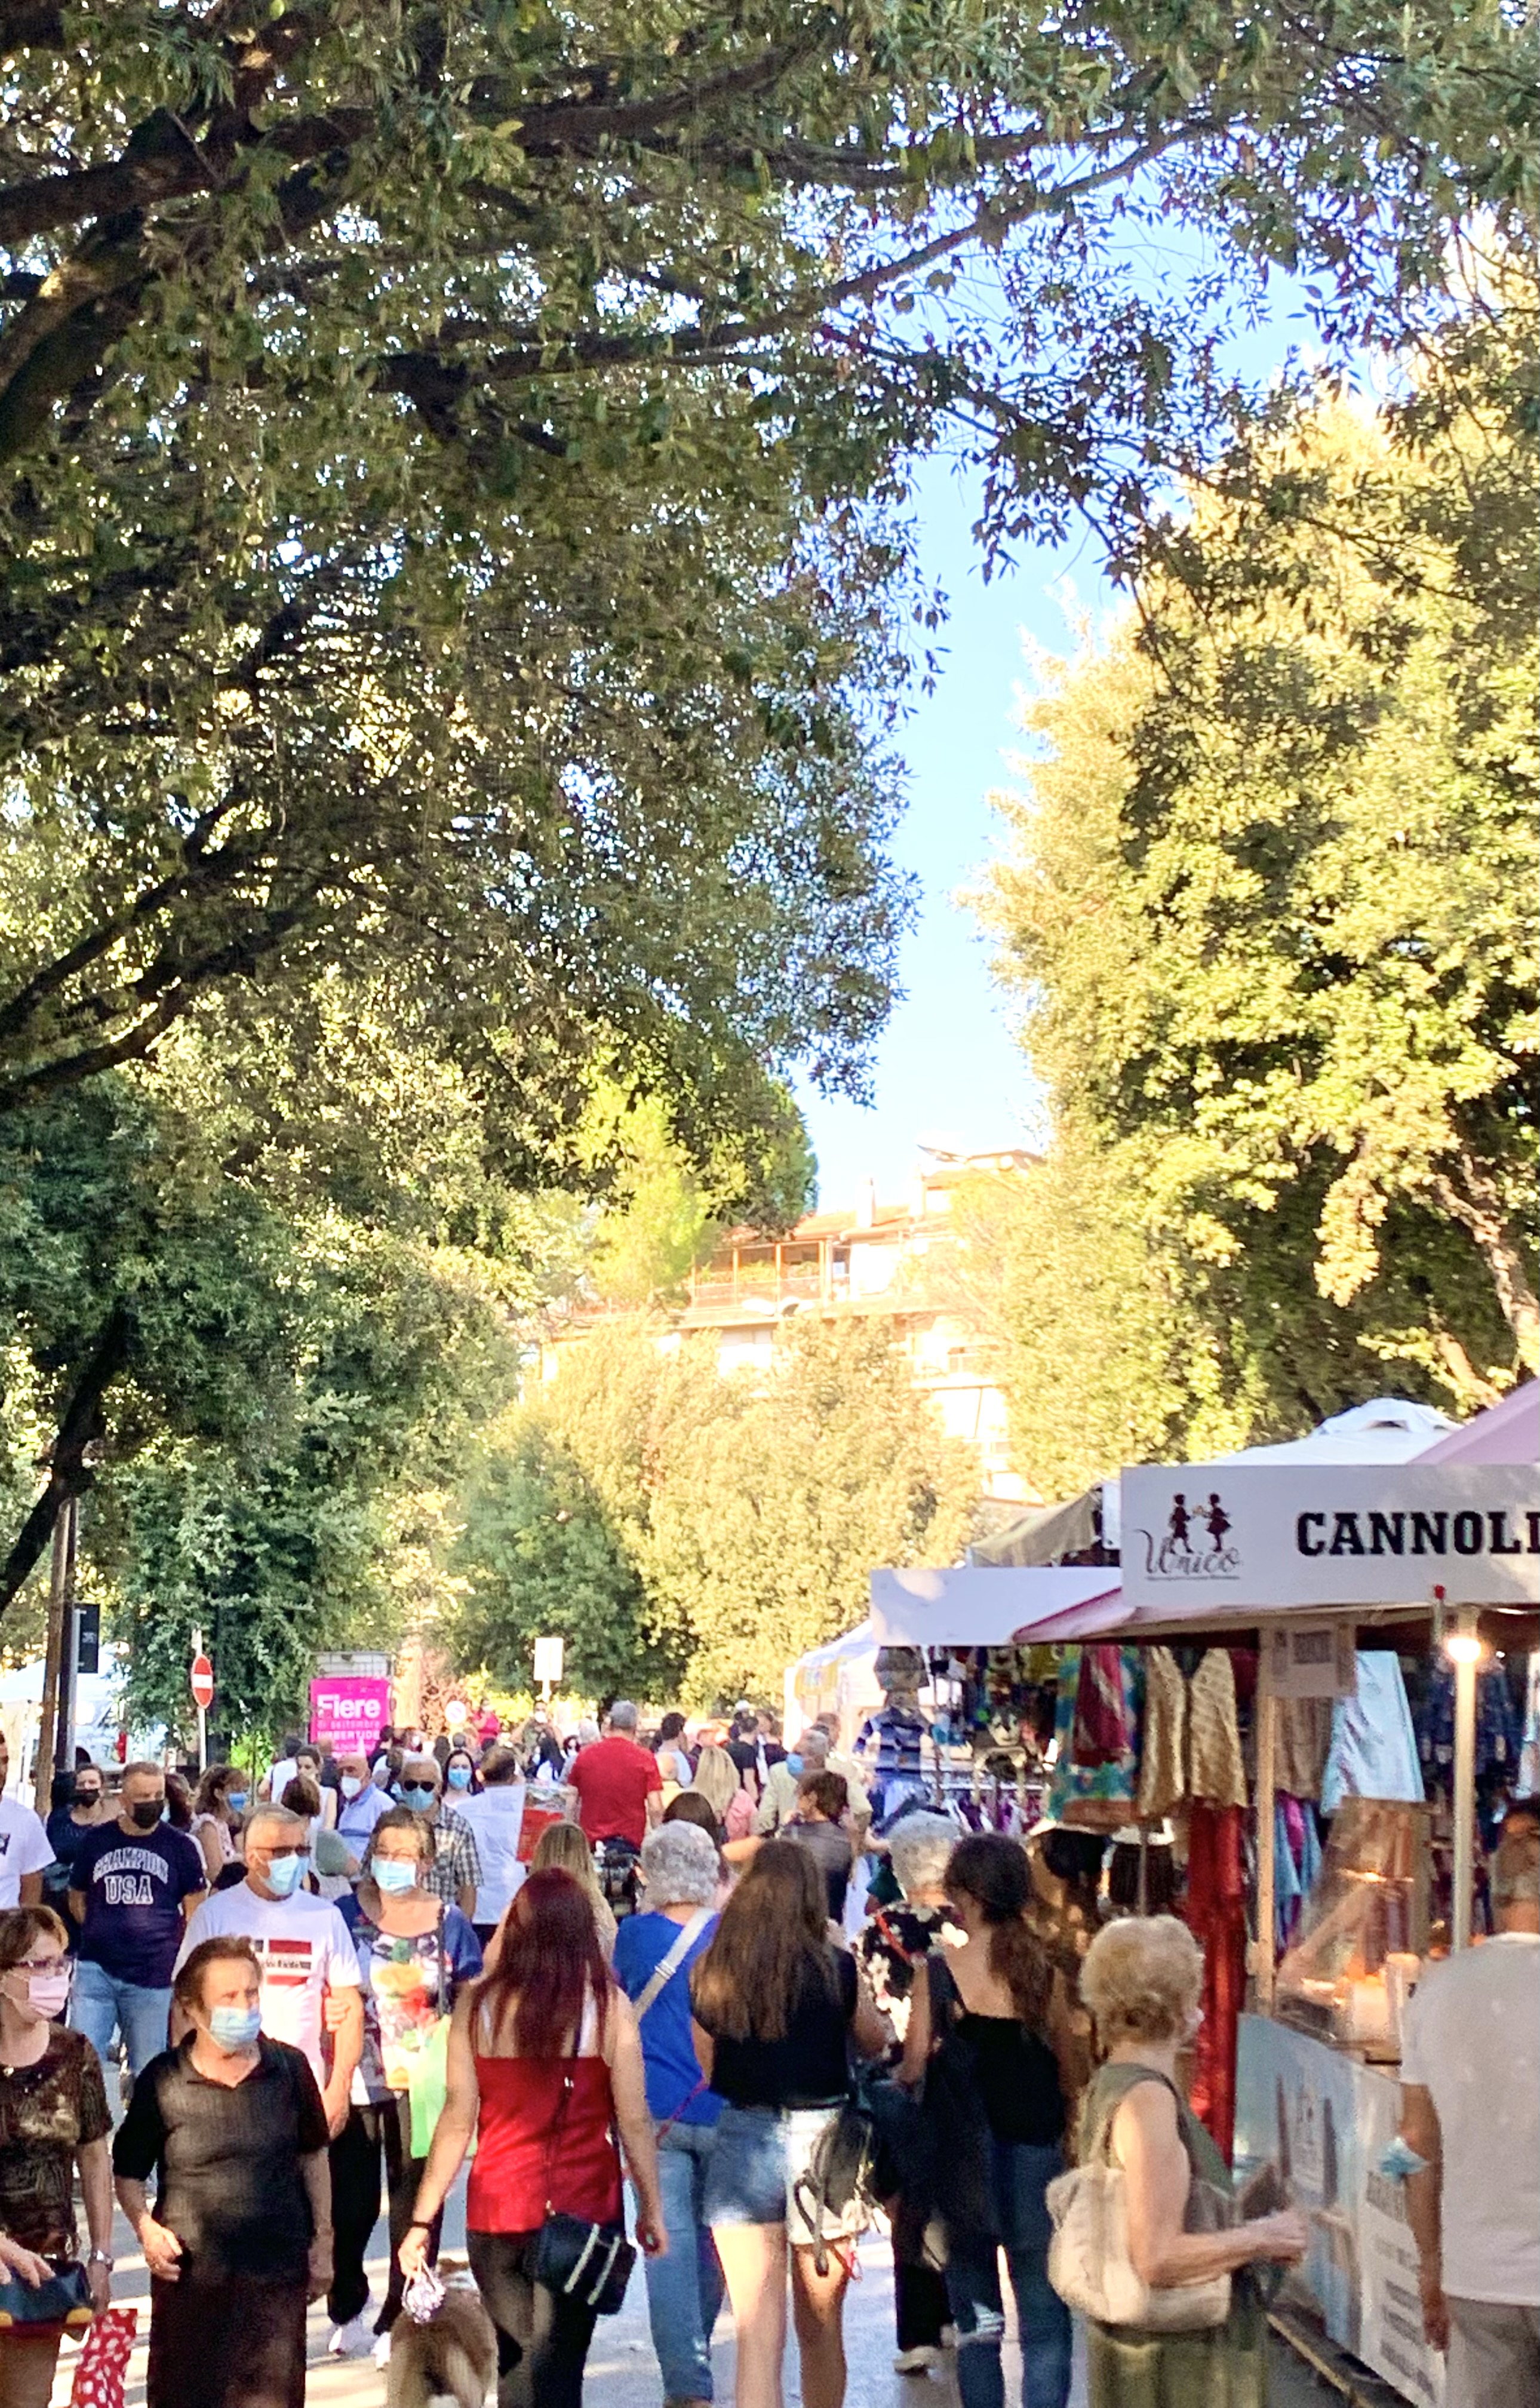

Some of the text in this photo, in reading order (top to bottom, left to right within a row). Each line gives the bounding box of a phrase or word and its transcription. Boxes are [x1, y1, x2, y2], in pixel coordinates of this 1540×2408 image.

[1297, 1511, 1540, 1556] CANNOLI
[317, 1694, 381, 1719] Fiere
[93, 1847, 168, 1884] CHAMPION
[104, 1875, 153, 1905] USA
